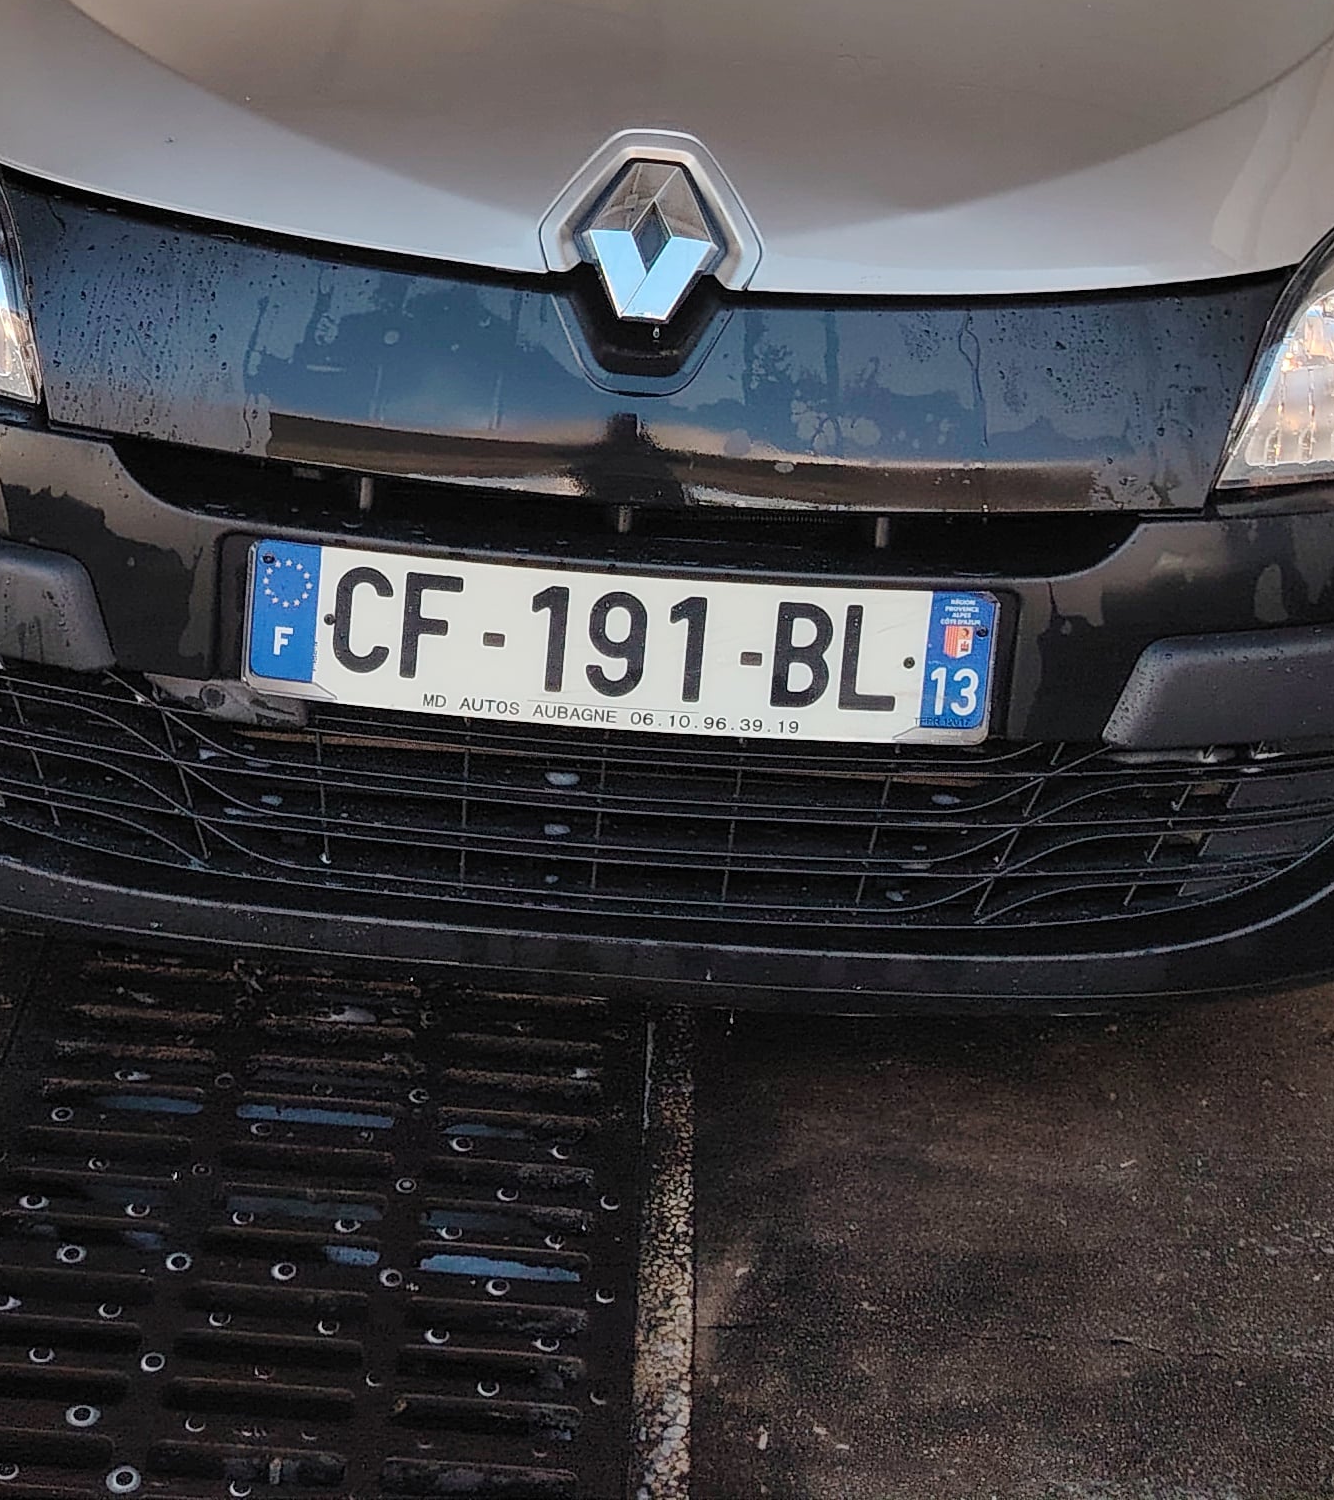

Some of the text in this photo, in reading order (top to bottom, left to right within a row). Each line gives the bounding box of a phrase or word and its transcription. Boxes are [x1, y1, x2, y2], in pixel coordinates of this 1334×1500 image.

[273, 626, 294, 656] F
[930, 666, 980, 717] 13
[422, 693, 447, 708] MD
[458, 697, 520, 716] AUTOS
[532, 704, 618, 724] AUBAGNE
